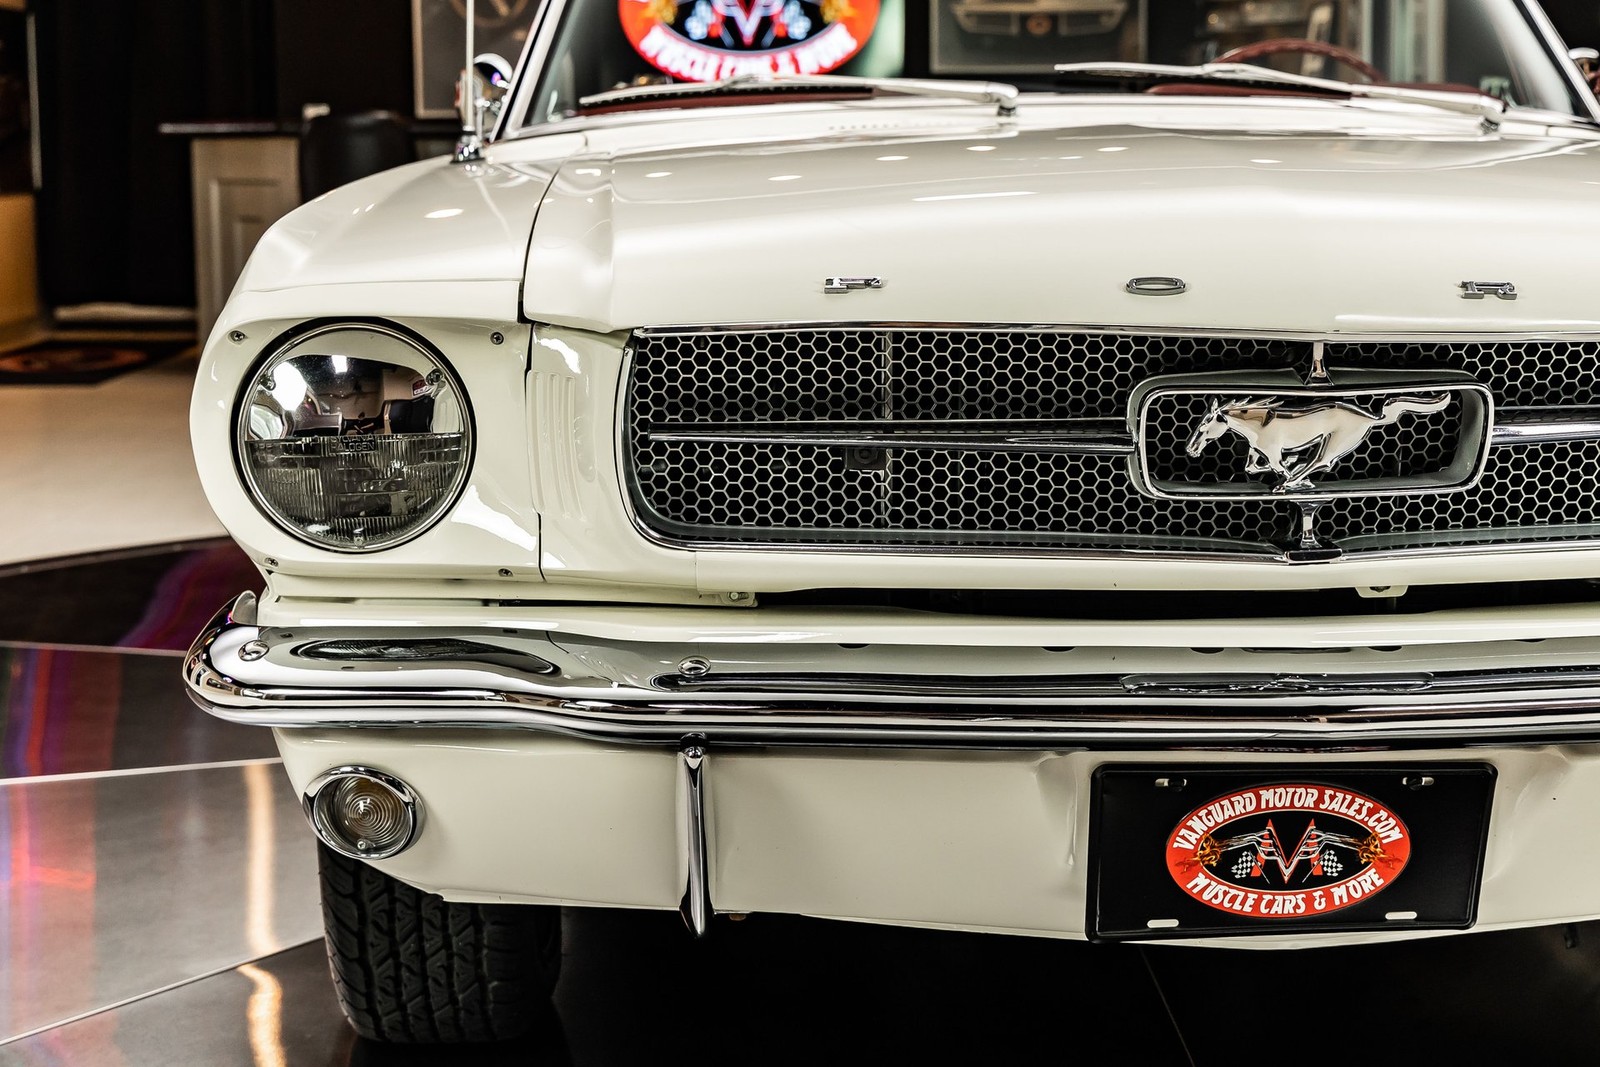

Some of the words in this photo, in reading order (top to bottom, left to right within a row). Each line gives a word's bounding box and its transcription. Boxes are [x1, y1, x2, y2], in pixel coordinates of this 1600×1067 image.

[330, 441, 375, 452] HALOGEN
[1172, 792, 1257, 850] VANGUARD
[1258, 787, 1319, 809] MOTOR
[1319, 789, 1404, 844] SALES.COM
[1186, 872, 1258, 912] MUSCLE
[1260, 894, 1306, 914] CARS
[1312, 890, 1326, 910] &
[1330, 868, 1385, 905] MORE
